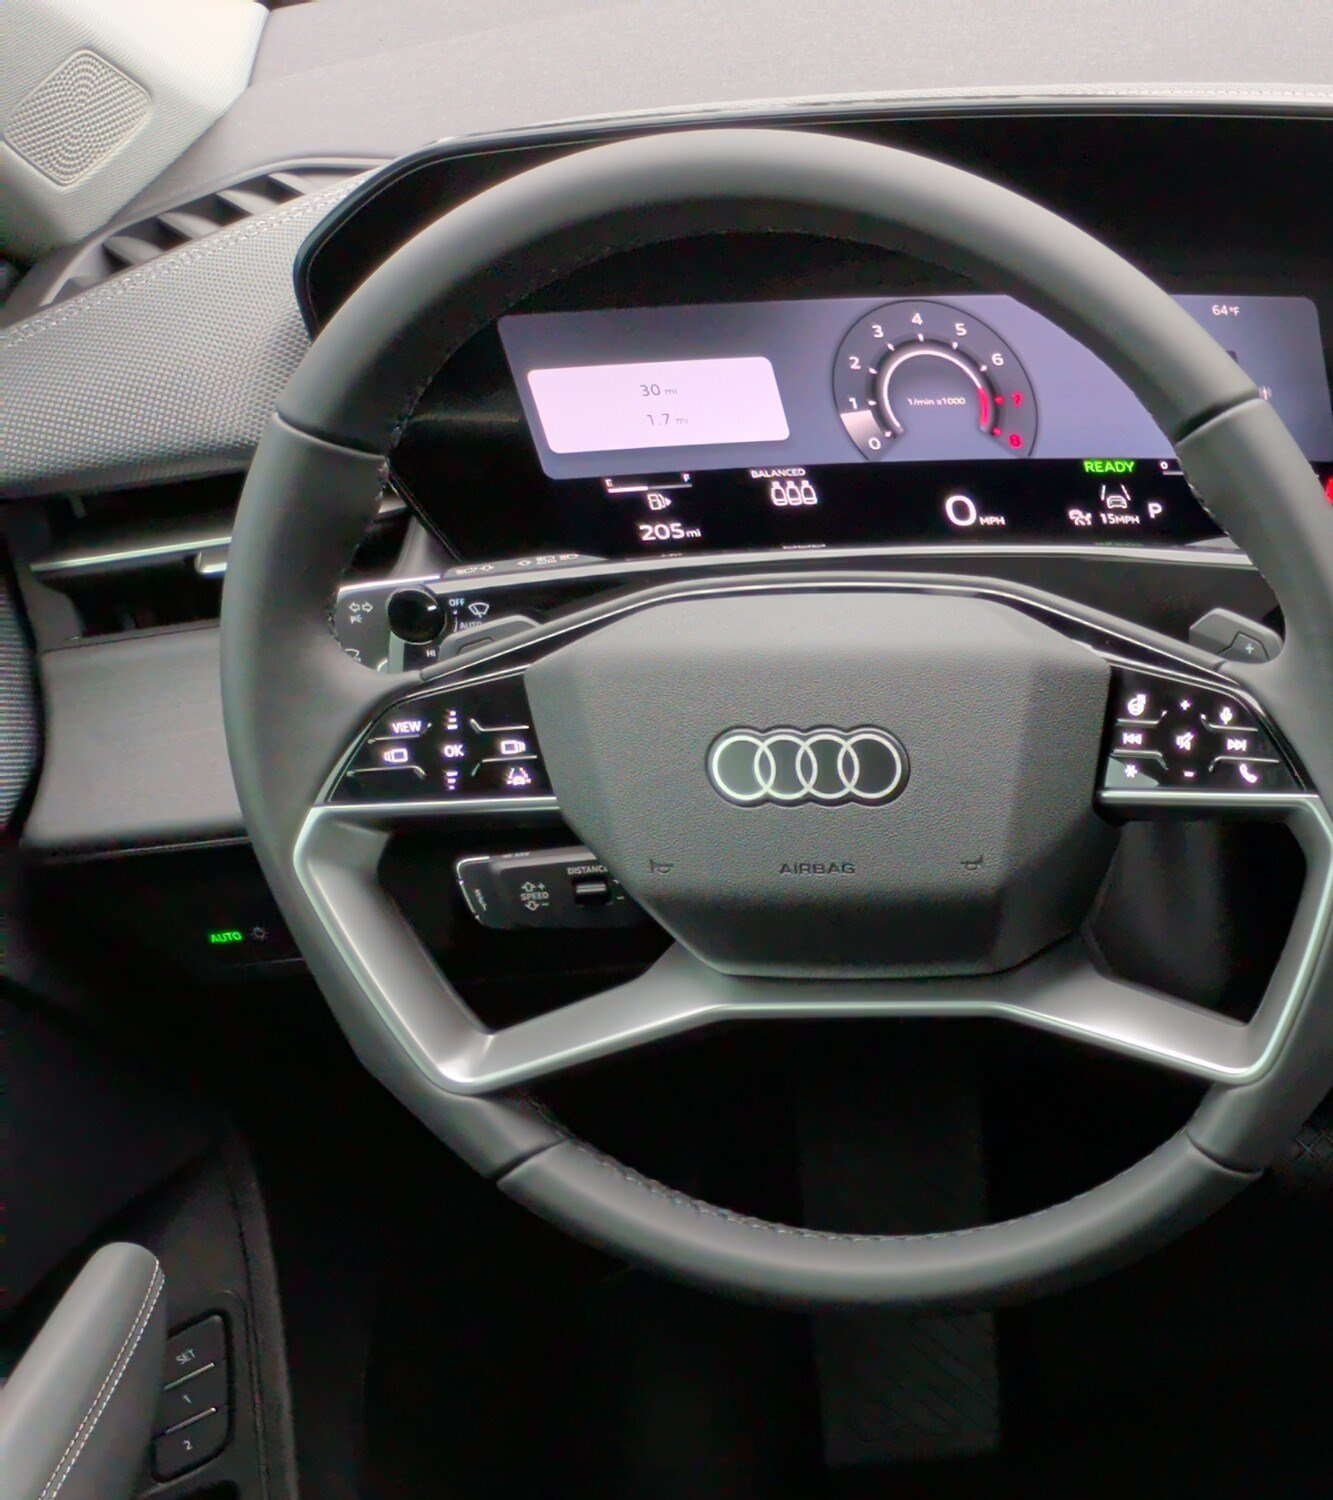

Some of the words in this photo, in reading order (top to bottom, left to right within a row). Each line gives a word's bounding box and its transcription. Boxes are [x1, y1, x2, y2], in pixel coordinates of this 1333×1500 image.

[911, 312, 924, 325] 4
[871, 324, 884, 338] 3
[955, 322, 968, 336] 5
[848, 356, 862, 370] 2
[991, 352, 1004, 366] 6
[639, 384, 660, 398] 30
[646, 413, 670, 426] 1.7
[1083, 460, 1135, 473] READY
[751, 468, 806, 479] BALANCED
[945, 495, 976, 527] 0
[978, 516, 1006, 526] MPH
[1148, 502, 1162, 519] P
[449, 598, 465, 608] OFF
[392, 720, 422, 734] VIEW
[444, 744, 464, 758] OK
[567, 865, 609, 876] DISTANC
[779, 862, 856, 875] AIRBAG
[520, 892, 549, 901] SPEED
[210, 931, 242, 944] AUTO
[176, 1348, 196, 1365] SET
[183, 1439, 194, 1451] 2
